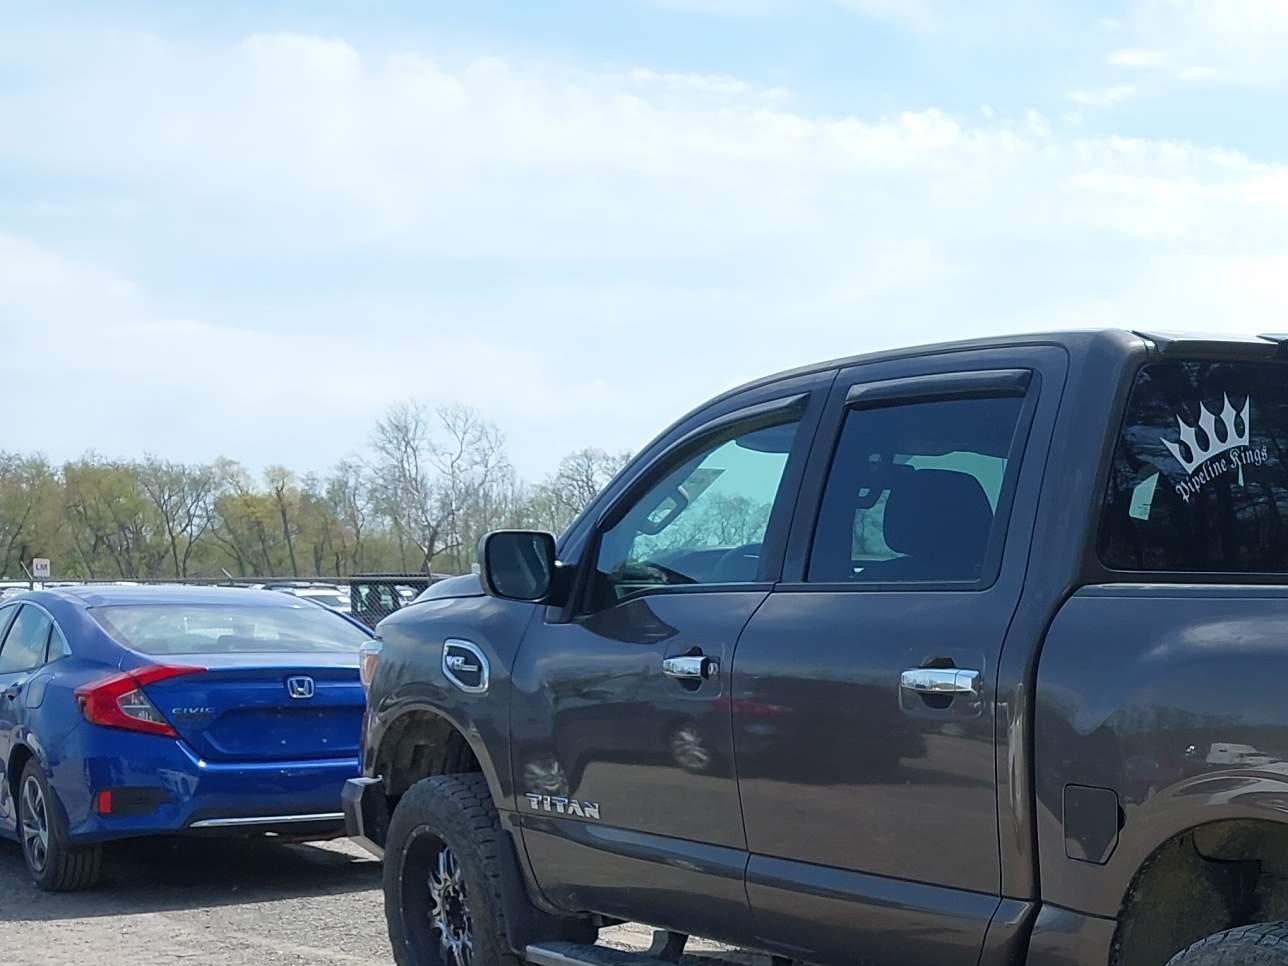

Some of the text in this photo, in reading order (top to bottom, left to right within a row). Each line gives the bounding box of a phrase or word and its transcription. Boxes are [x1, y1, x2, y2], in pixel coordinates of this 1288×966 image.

[1175, 446, 1268, 503] Pipeline Kings
[172, 706, 216, 714] CIVIC
[525, 792, 600, 819] TITAN
